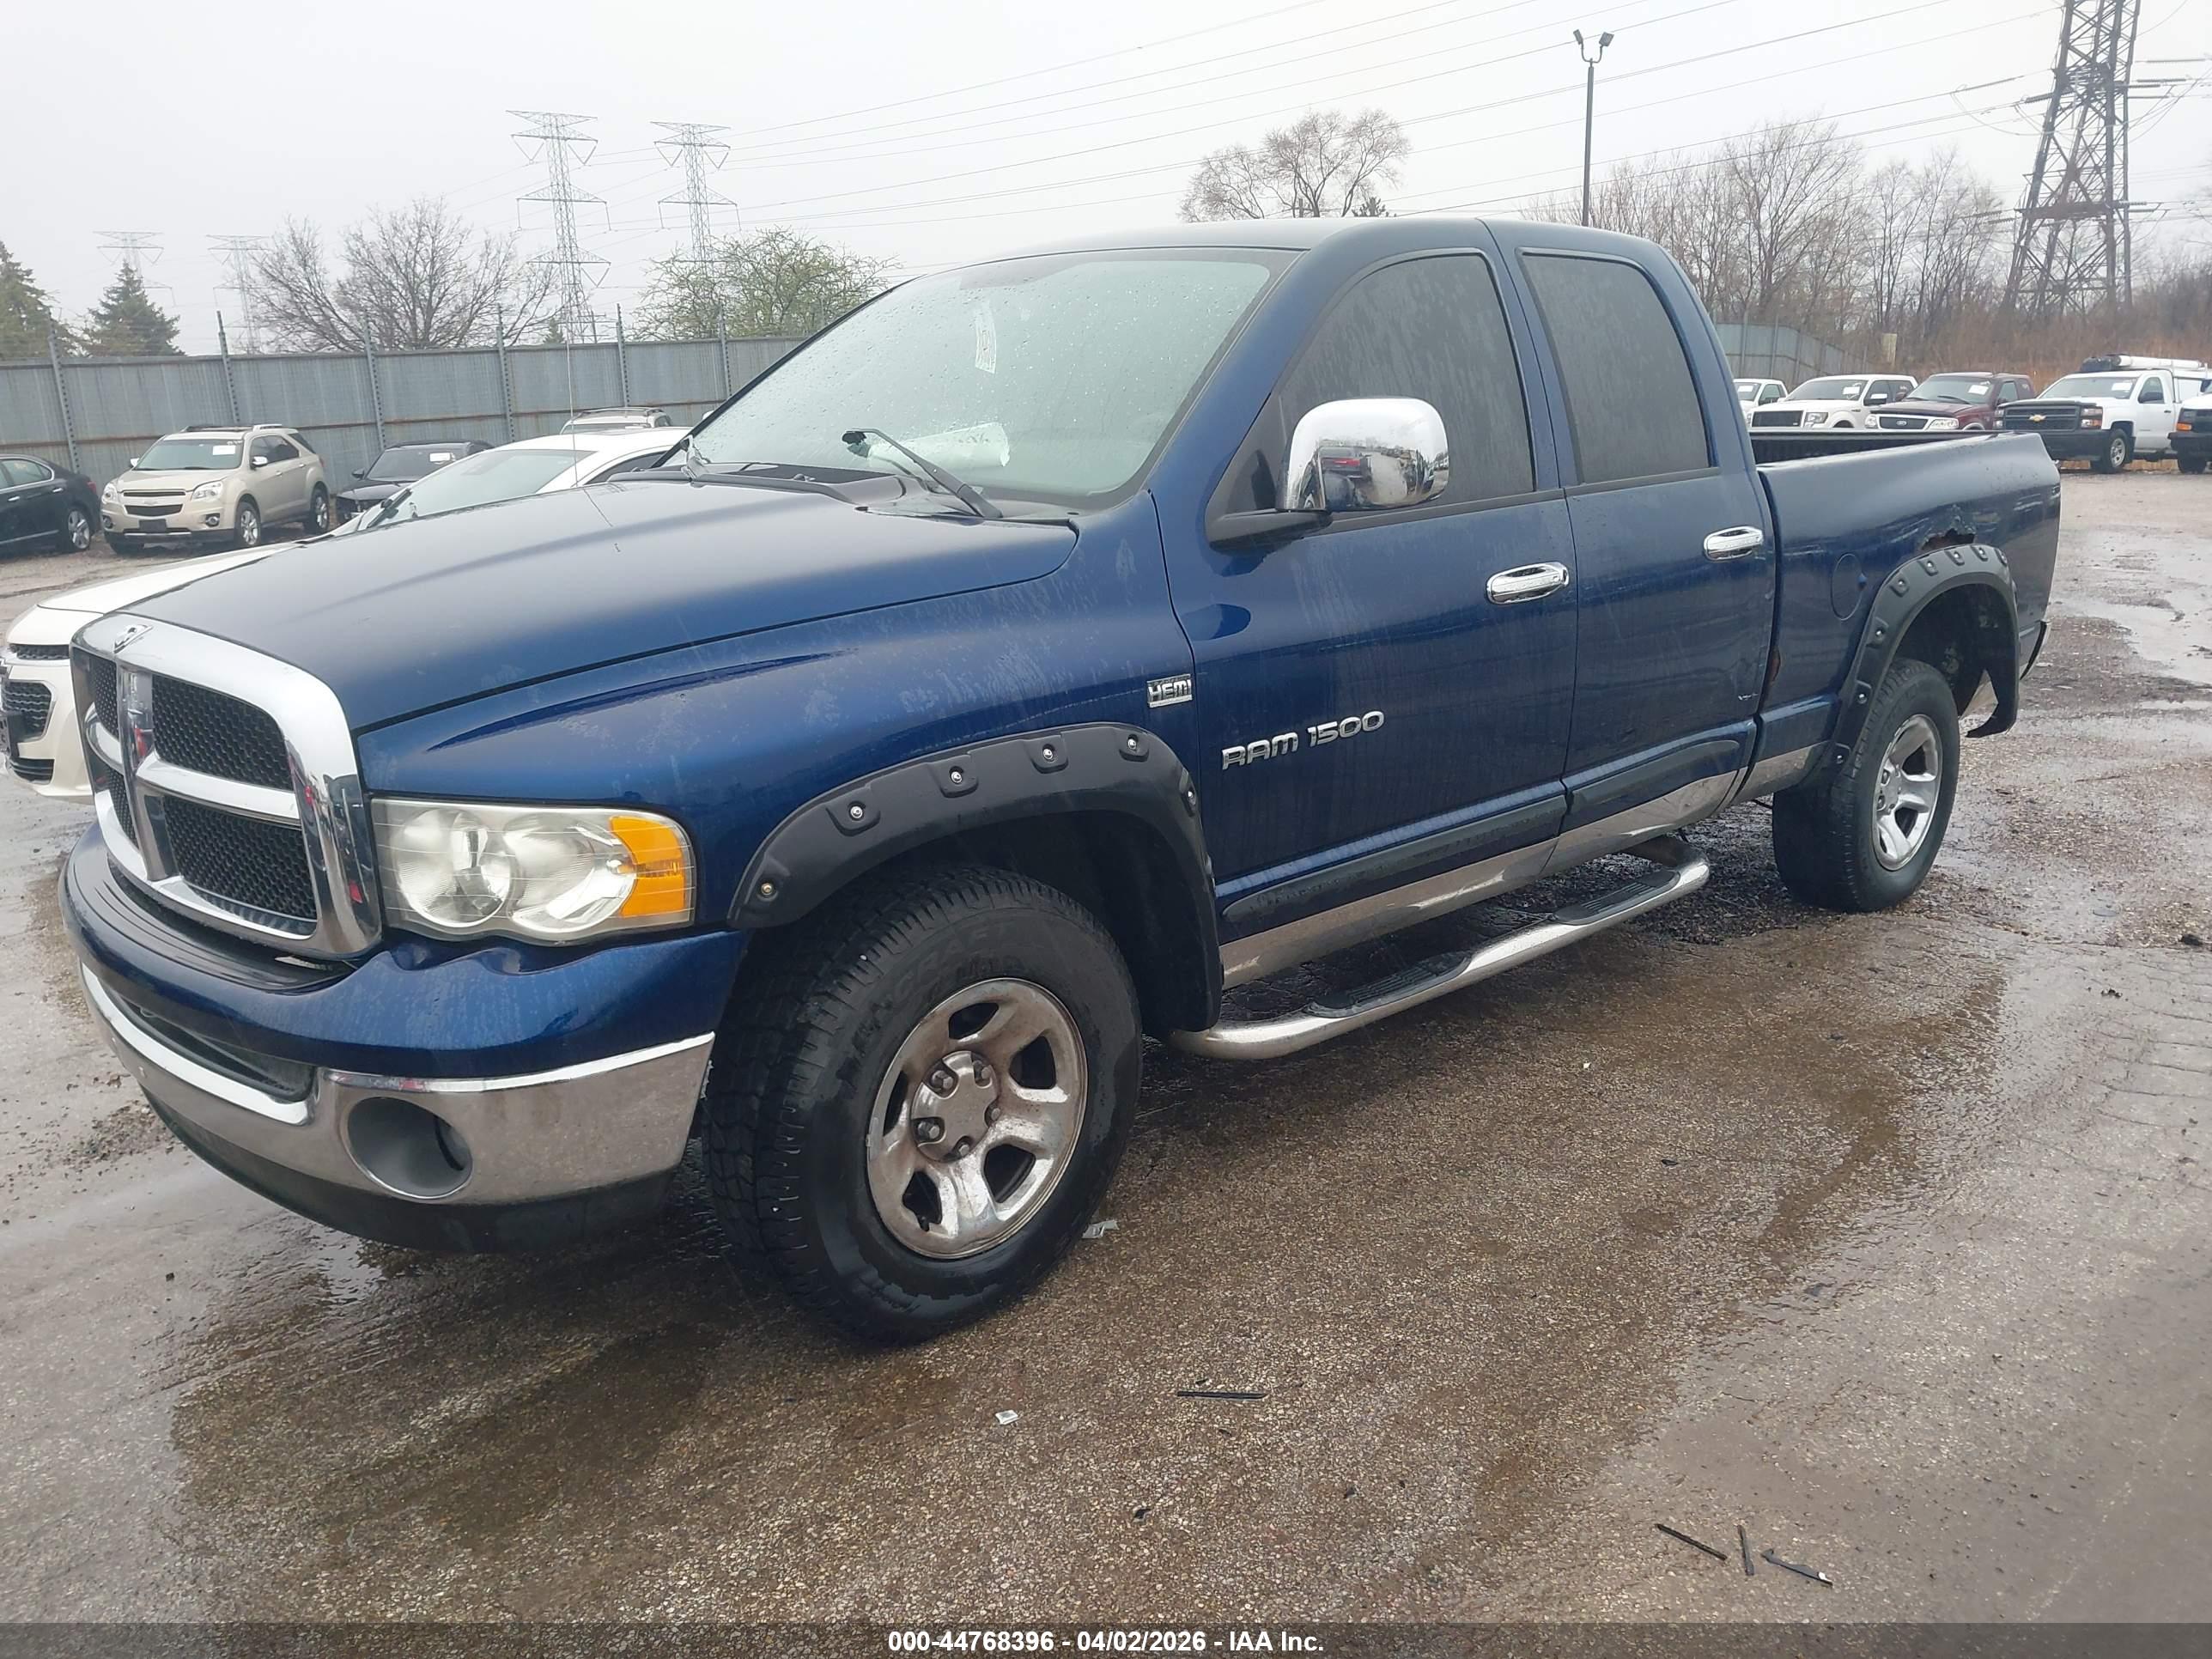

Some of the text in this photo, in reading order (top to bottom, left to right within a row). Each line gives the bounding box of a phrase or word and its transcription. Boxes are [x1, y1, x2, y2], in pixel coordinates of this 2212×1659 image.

[1147, 678, 1193, 703] HEMI
[1221, 710, 1385, 770] RAM 1500
